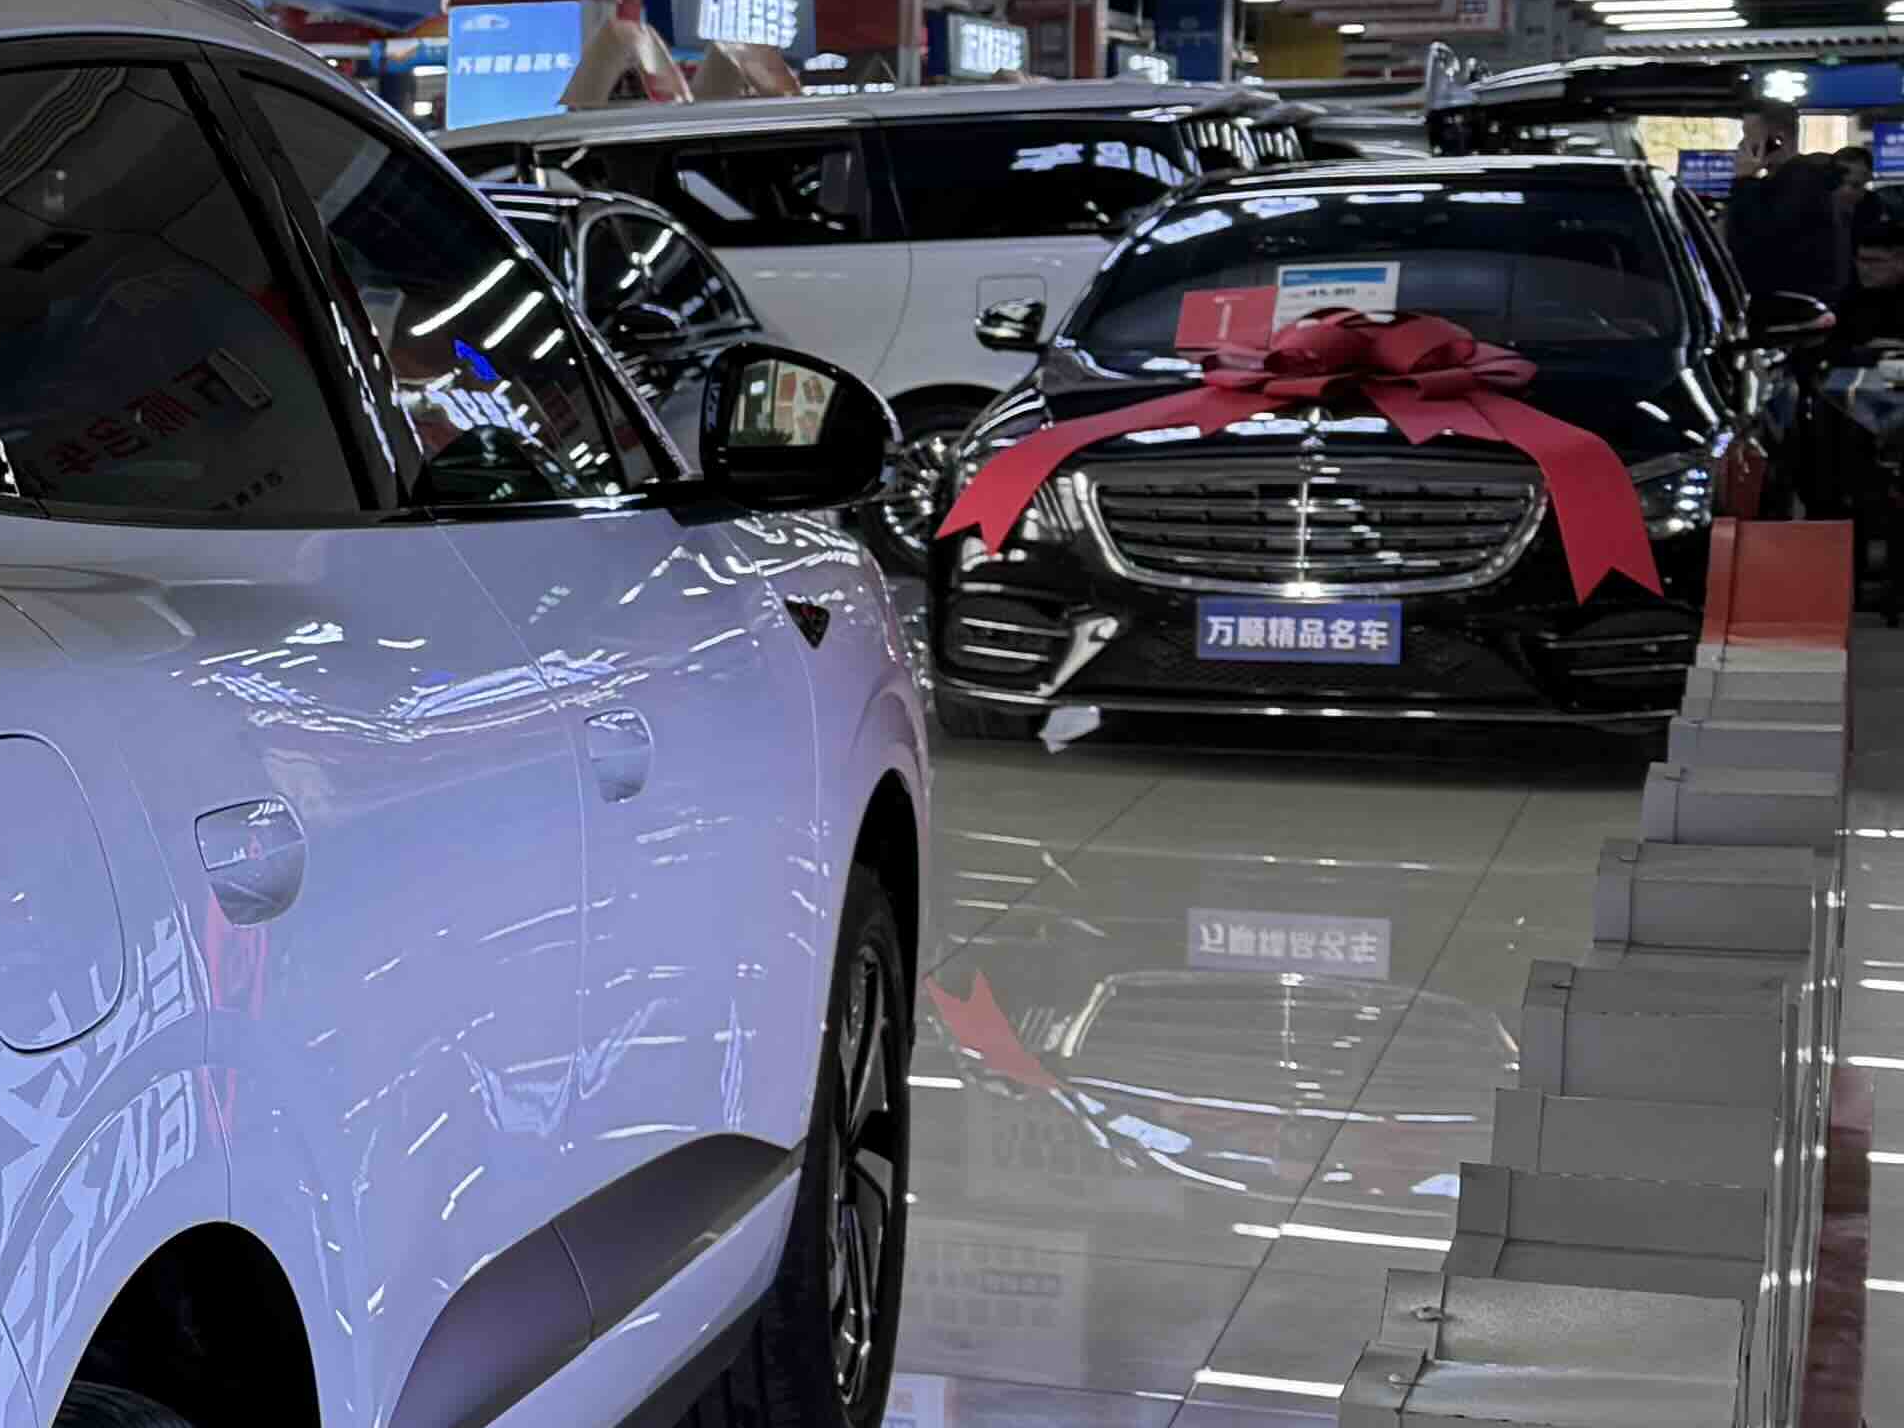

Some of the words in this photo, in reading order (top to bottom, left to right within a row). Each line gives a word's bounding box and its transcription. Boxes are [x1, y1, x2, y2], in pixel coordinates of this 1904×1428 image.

[1206, 615, 1390, 651] 万顺精品名车
